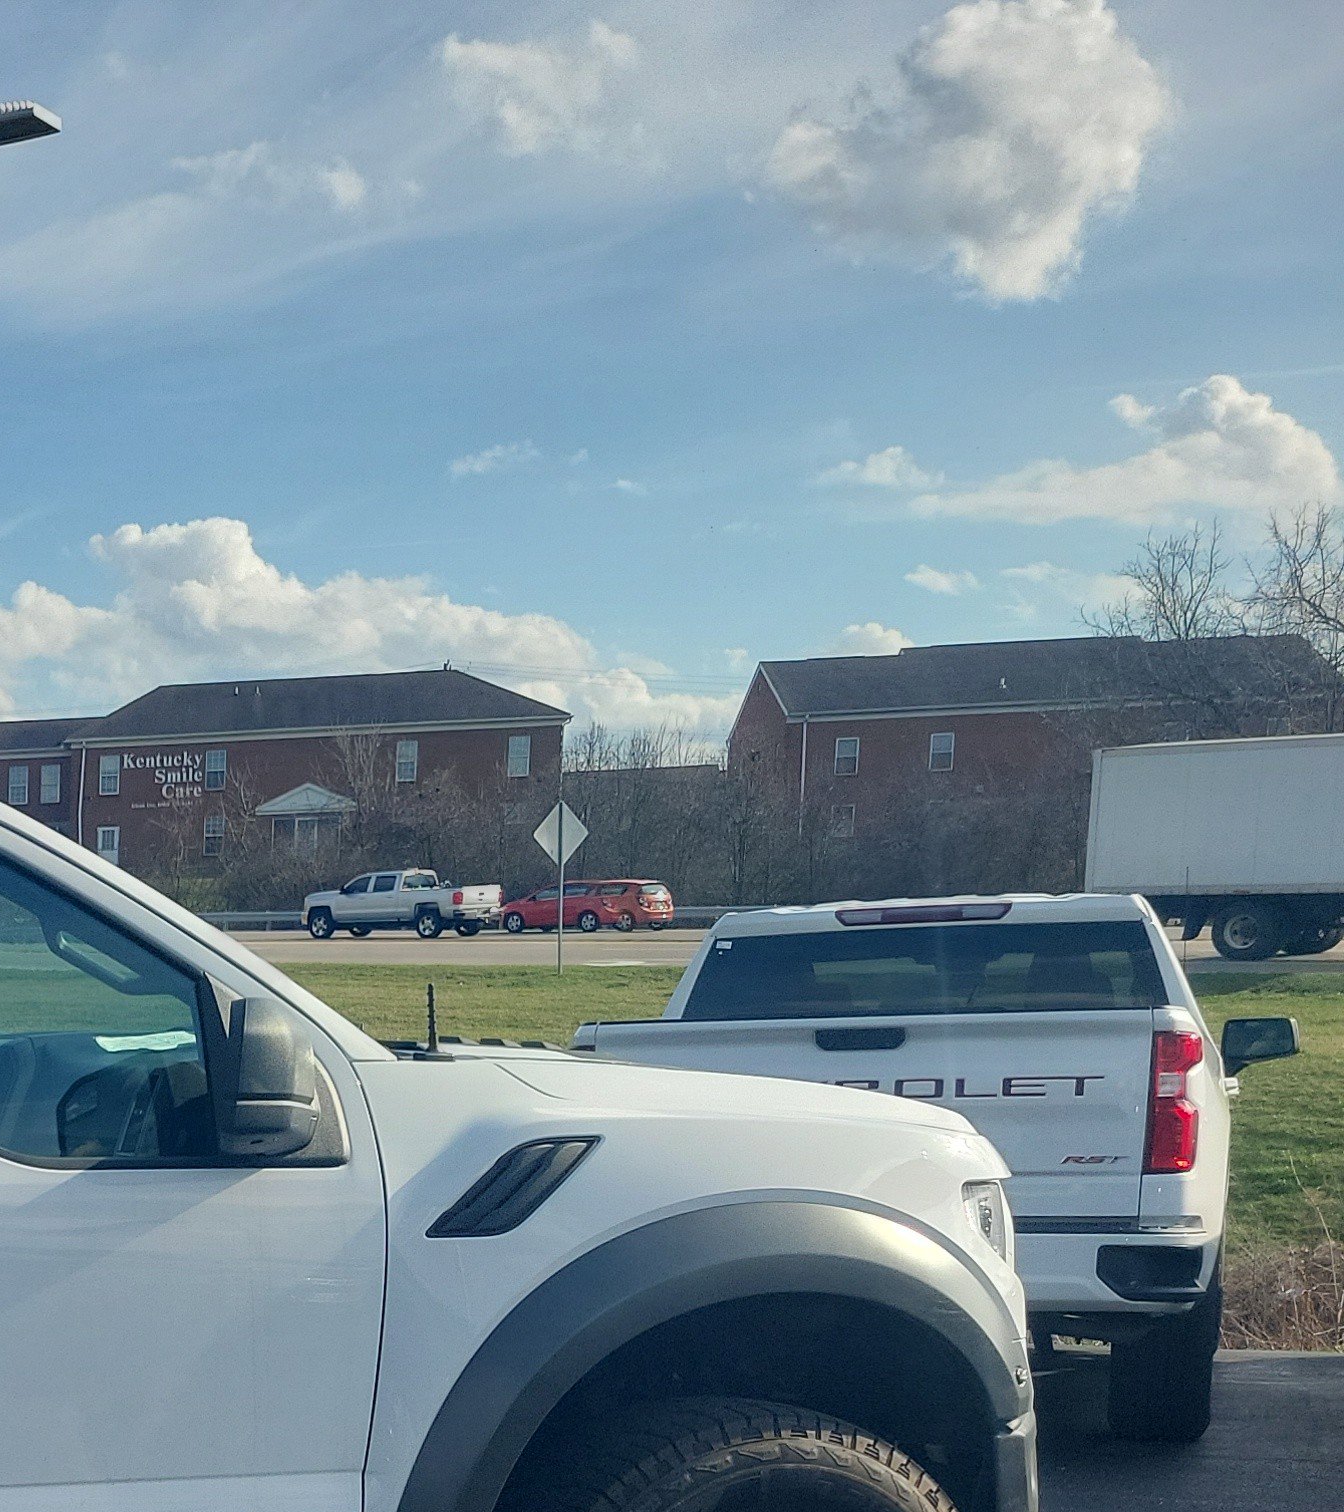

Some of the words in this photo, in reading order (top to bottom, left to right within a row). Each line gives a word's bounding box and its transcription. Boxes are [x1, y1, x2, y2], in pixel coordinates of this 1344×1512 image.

[123, 751, 203, 769] Kentucky
[154, 767, 203, 784] Smile
[161, 783, 202, 799] Care
[1060, 1155, 1132, 1165] RST
